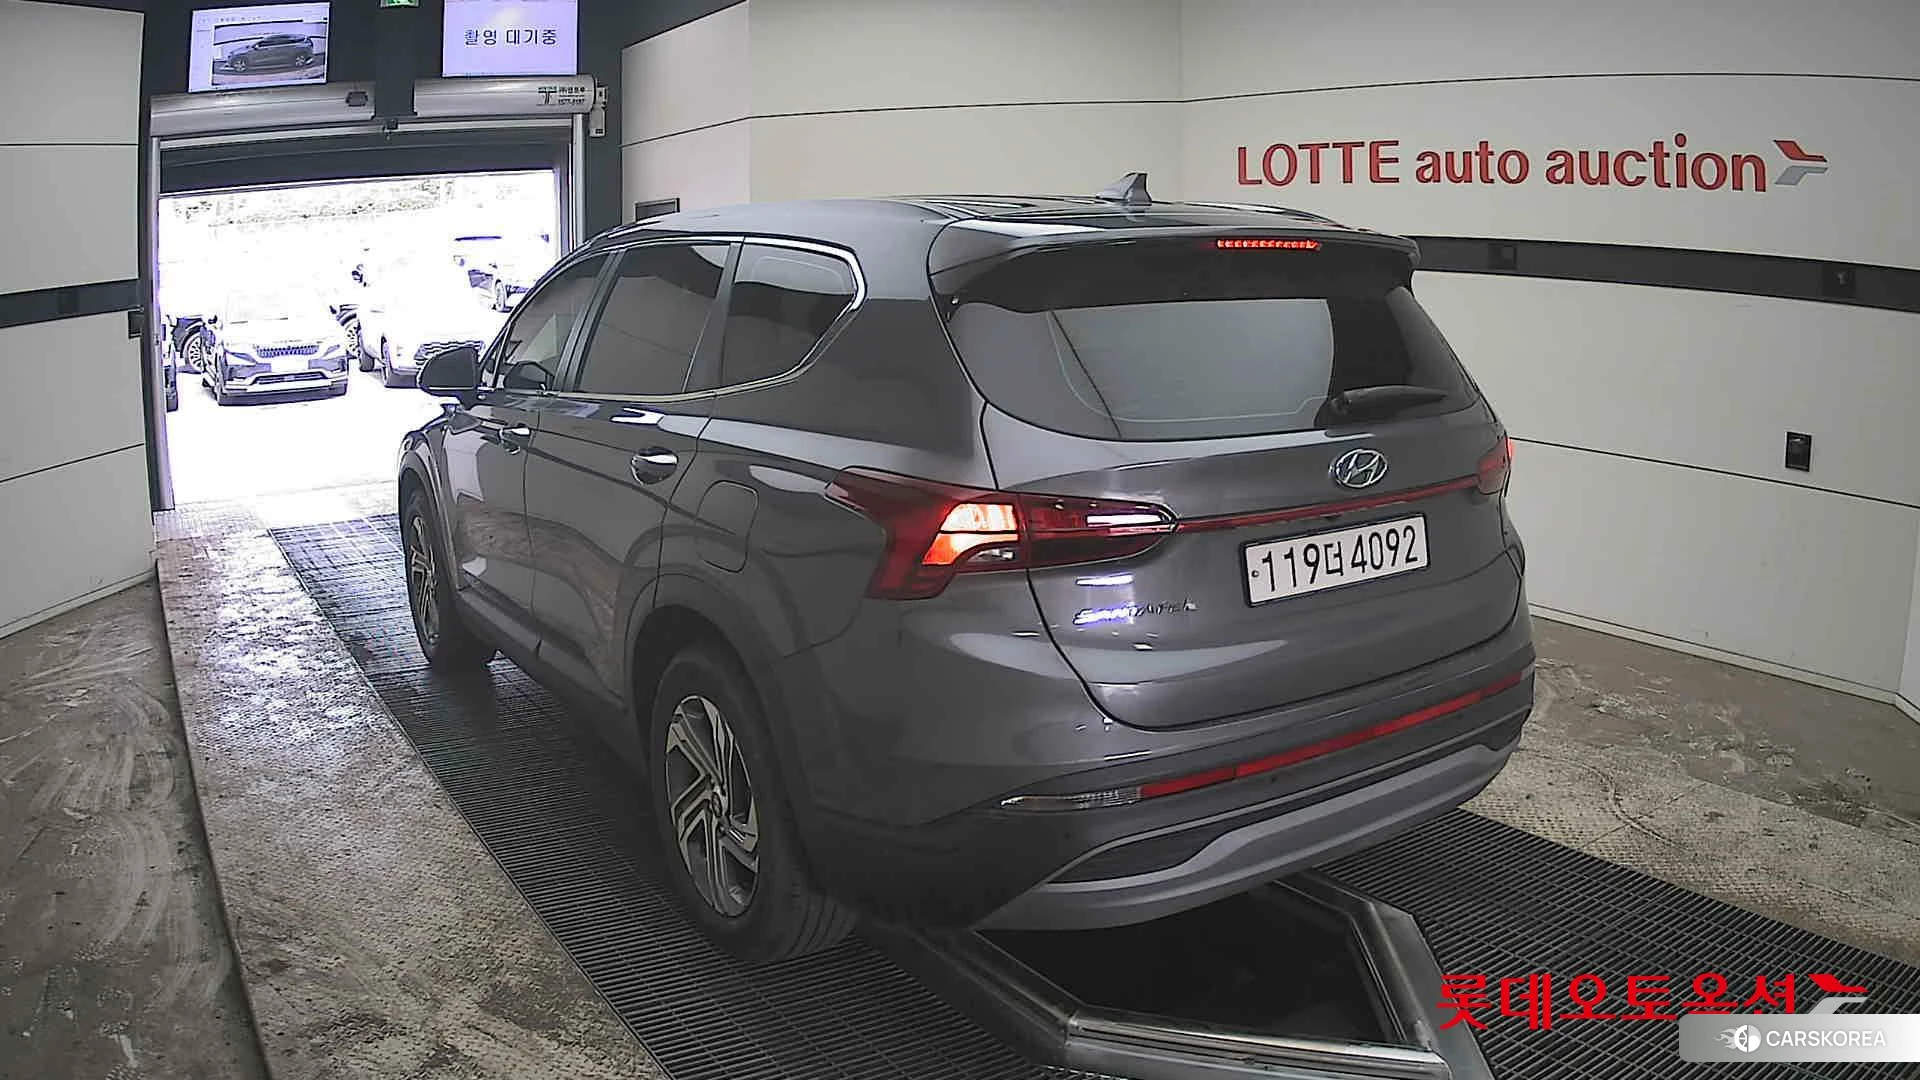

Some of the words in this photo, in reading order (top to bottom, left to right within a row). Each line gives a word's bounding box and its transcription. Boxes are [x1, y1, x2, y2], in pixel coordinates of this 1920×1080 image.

[505, 28, 557, 46] 대기중
[1237, 139, 1400, 187] LOTTE
[1415, 140, 1530, 185] auto
[1545, 132, 1767, 193] auction
